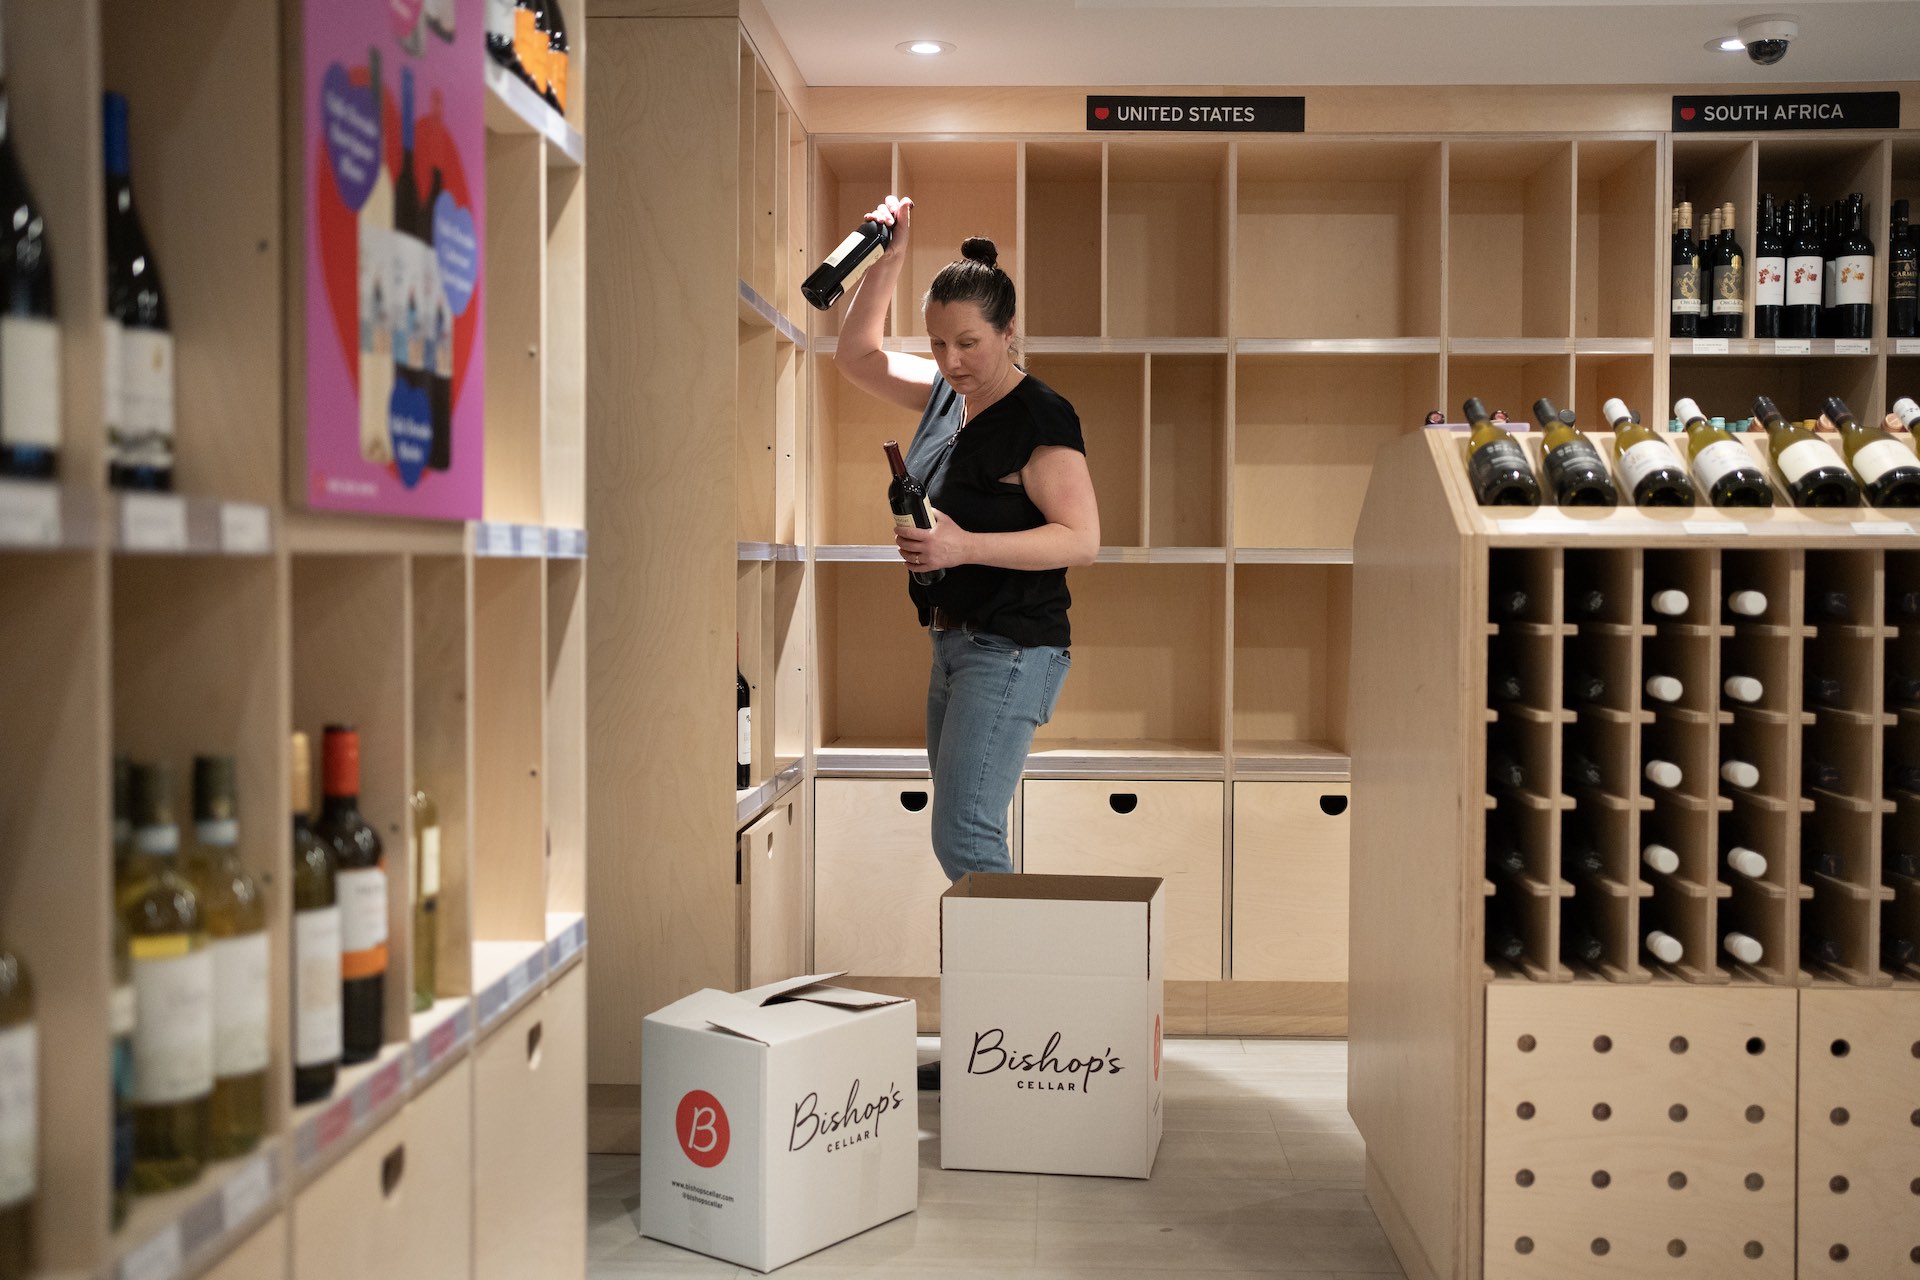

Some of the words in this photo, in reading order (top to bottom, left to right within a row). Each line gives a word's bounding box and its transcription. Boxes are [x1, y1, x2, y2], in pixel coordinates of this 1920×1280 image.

[1117, 106, 1184, 121] UNITED
[1189, 106, 1255, 122] STATES
[1703, 105, 1768, 121] SOUTH
[1774, 103, 1844, 120] AFRICA
[967, 1028, 1125, 1093] Bishop's
[1017, 1080, 1075, 1091] CELLAR
[788, 1078, 904, 1152] Bishop's
[688, 1106, 717, 1152] B
[827, 1130, 870, 1153] CELLAR
[671, 1179, 735, 1203] www.bishopscellar.com
[682, 1191, 723, 1209] @bishopscellar
